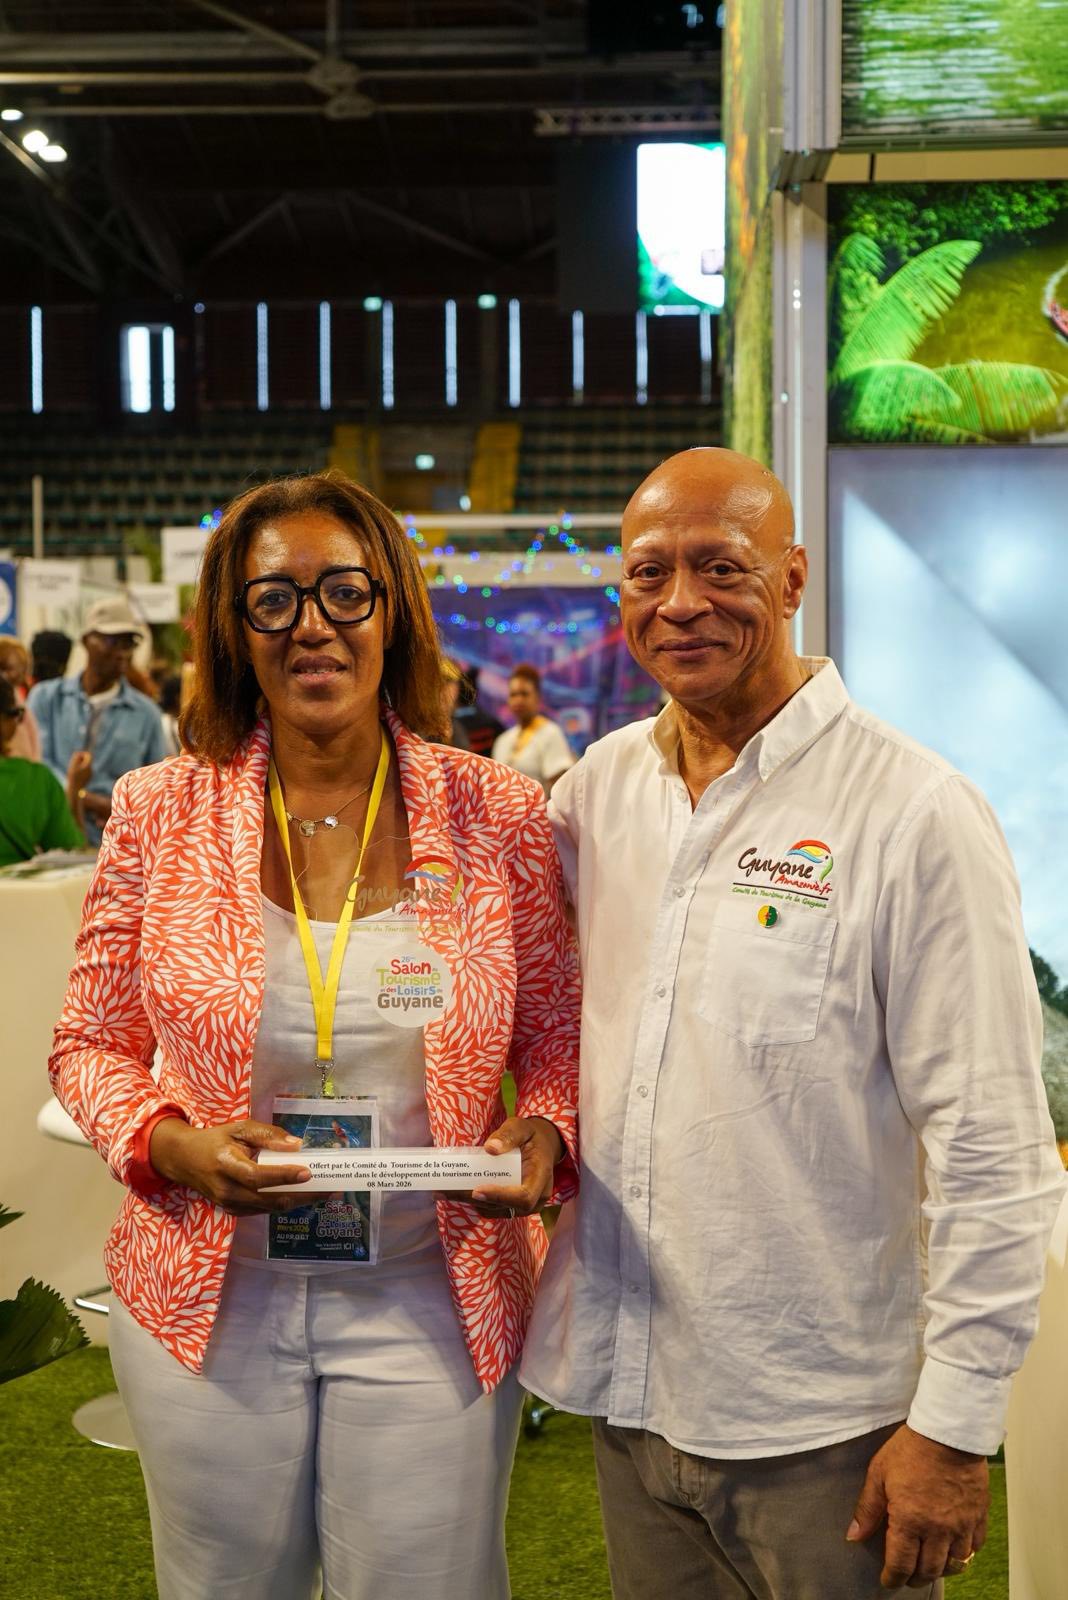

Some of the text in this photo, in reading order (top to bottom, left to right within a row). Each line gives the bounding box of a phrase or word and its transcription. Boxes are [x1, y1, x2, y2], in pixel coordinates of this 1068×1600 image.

[738, 847, 814, 882] Guyane
[345, 875, 442, 913] Guyane
[391, 959, 432, 975] Salon
[375, 968, 441, 986] Tourisme
[397, 985, 436, 996] Loisirs
[377, 993, 444, 1011] Guyane
[391, 1161, 423, 1169] Tourisme
[441, 1161, 470, 1169] Guyane,
[378, 1170, 431, 1178] développement
[483, 1170, 512, 1178] Guyane,
[278, 1216, 288, 1224] 05
[316, 1227, 362, 1239] Guyane
